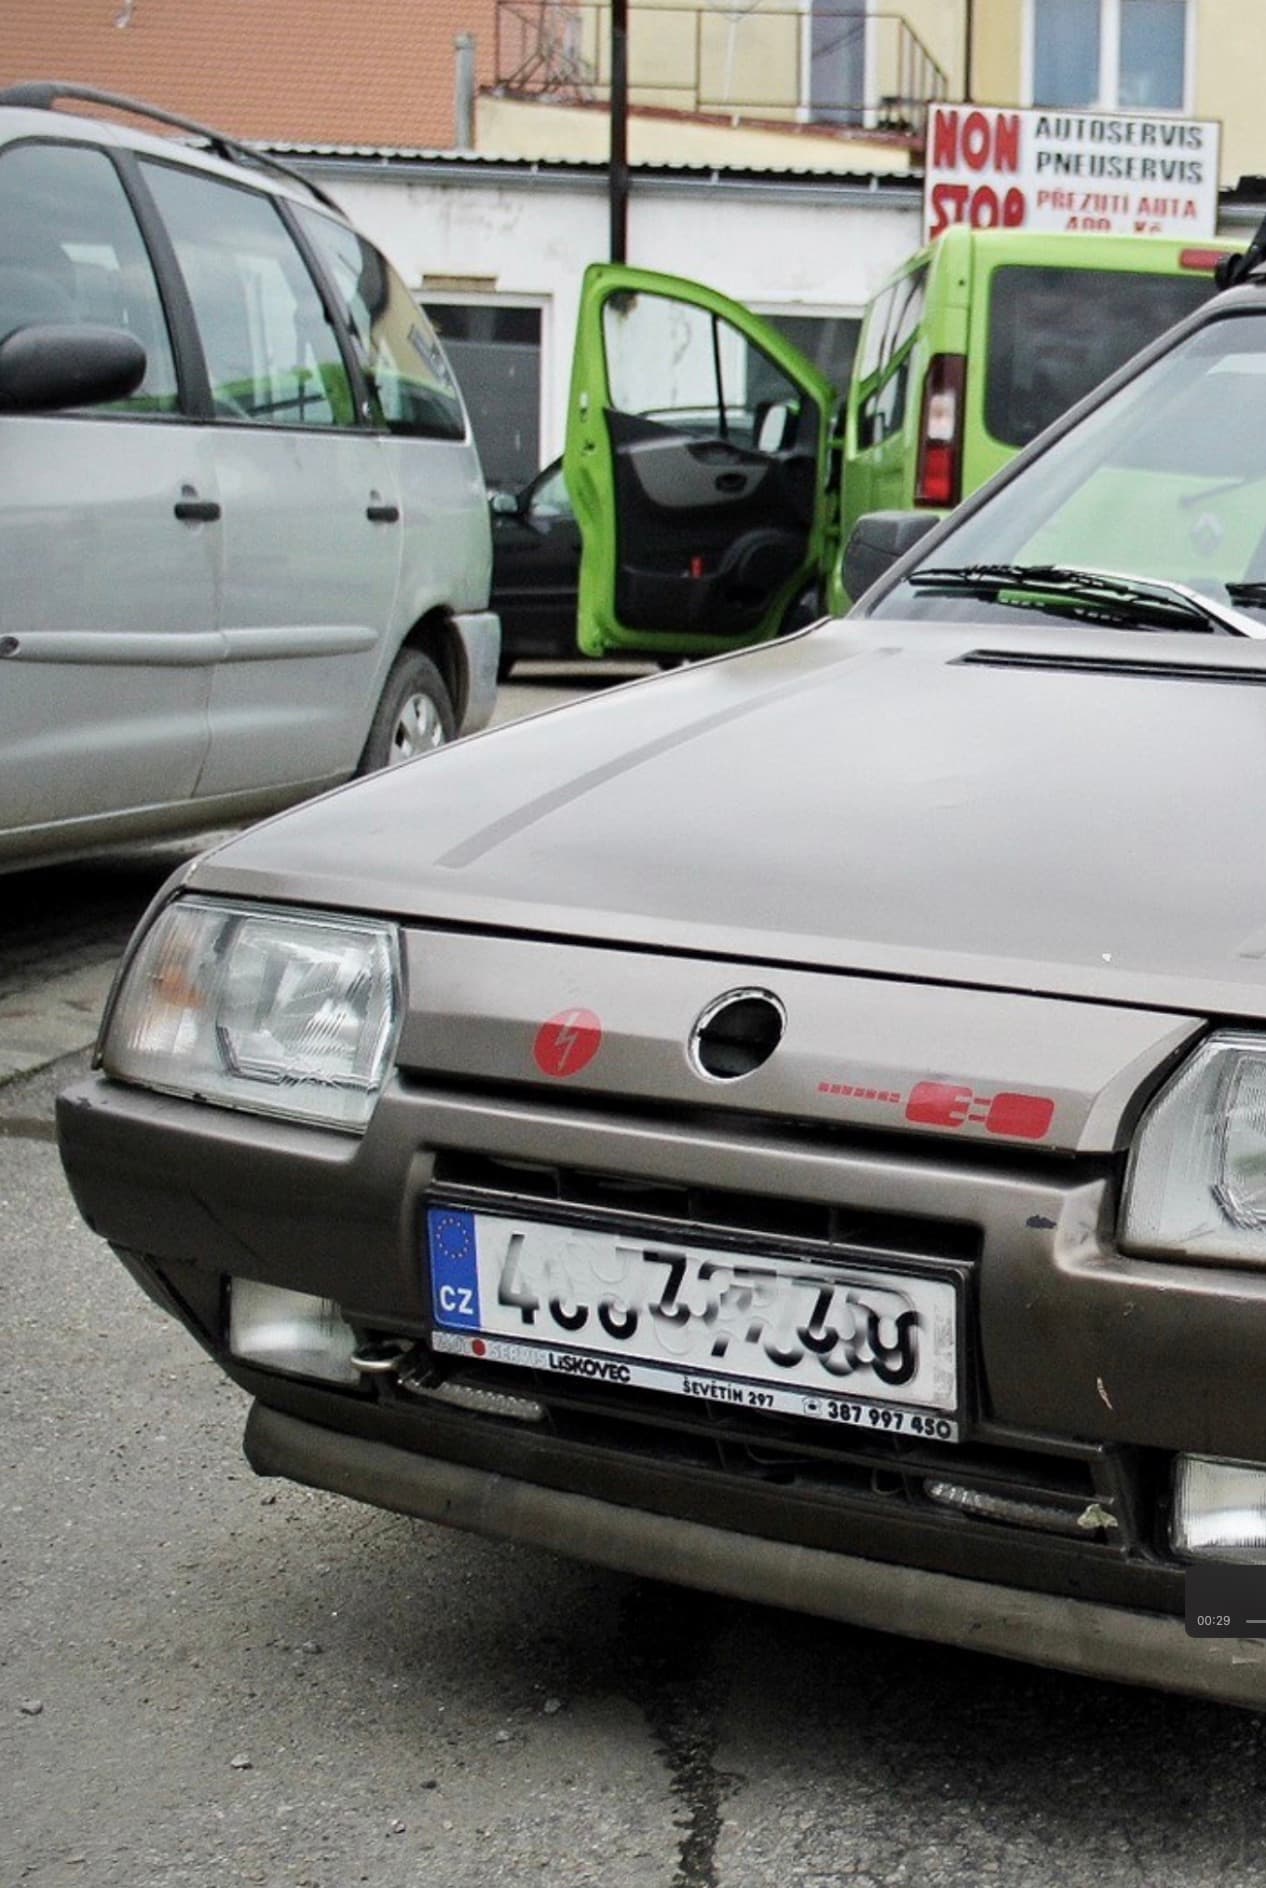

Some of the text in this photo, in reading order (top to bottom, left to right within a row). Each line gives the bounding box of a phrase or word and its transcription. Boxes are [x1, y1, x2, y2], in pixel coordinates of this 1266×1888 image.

[934, 110, 1019, 173] NON
[1036, 116, 1204, 150] AUTOSERVIS
[1036, 151, 1203, 184] PNEUSERVIS
[930, 184, 1025, 238] STOP
[1137, 197, 1198, 219] AUTA
[440, 1286, 475, 1314] CZ
[749, 1391, 775, 1408] 297
[828, 1401, 861, 1423] 387
[869, 1409, 904, 1432] 997
[911, 1417, 951, 1440] 450
